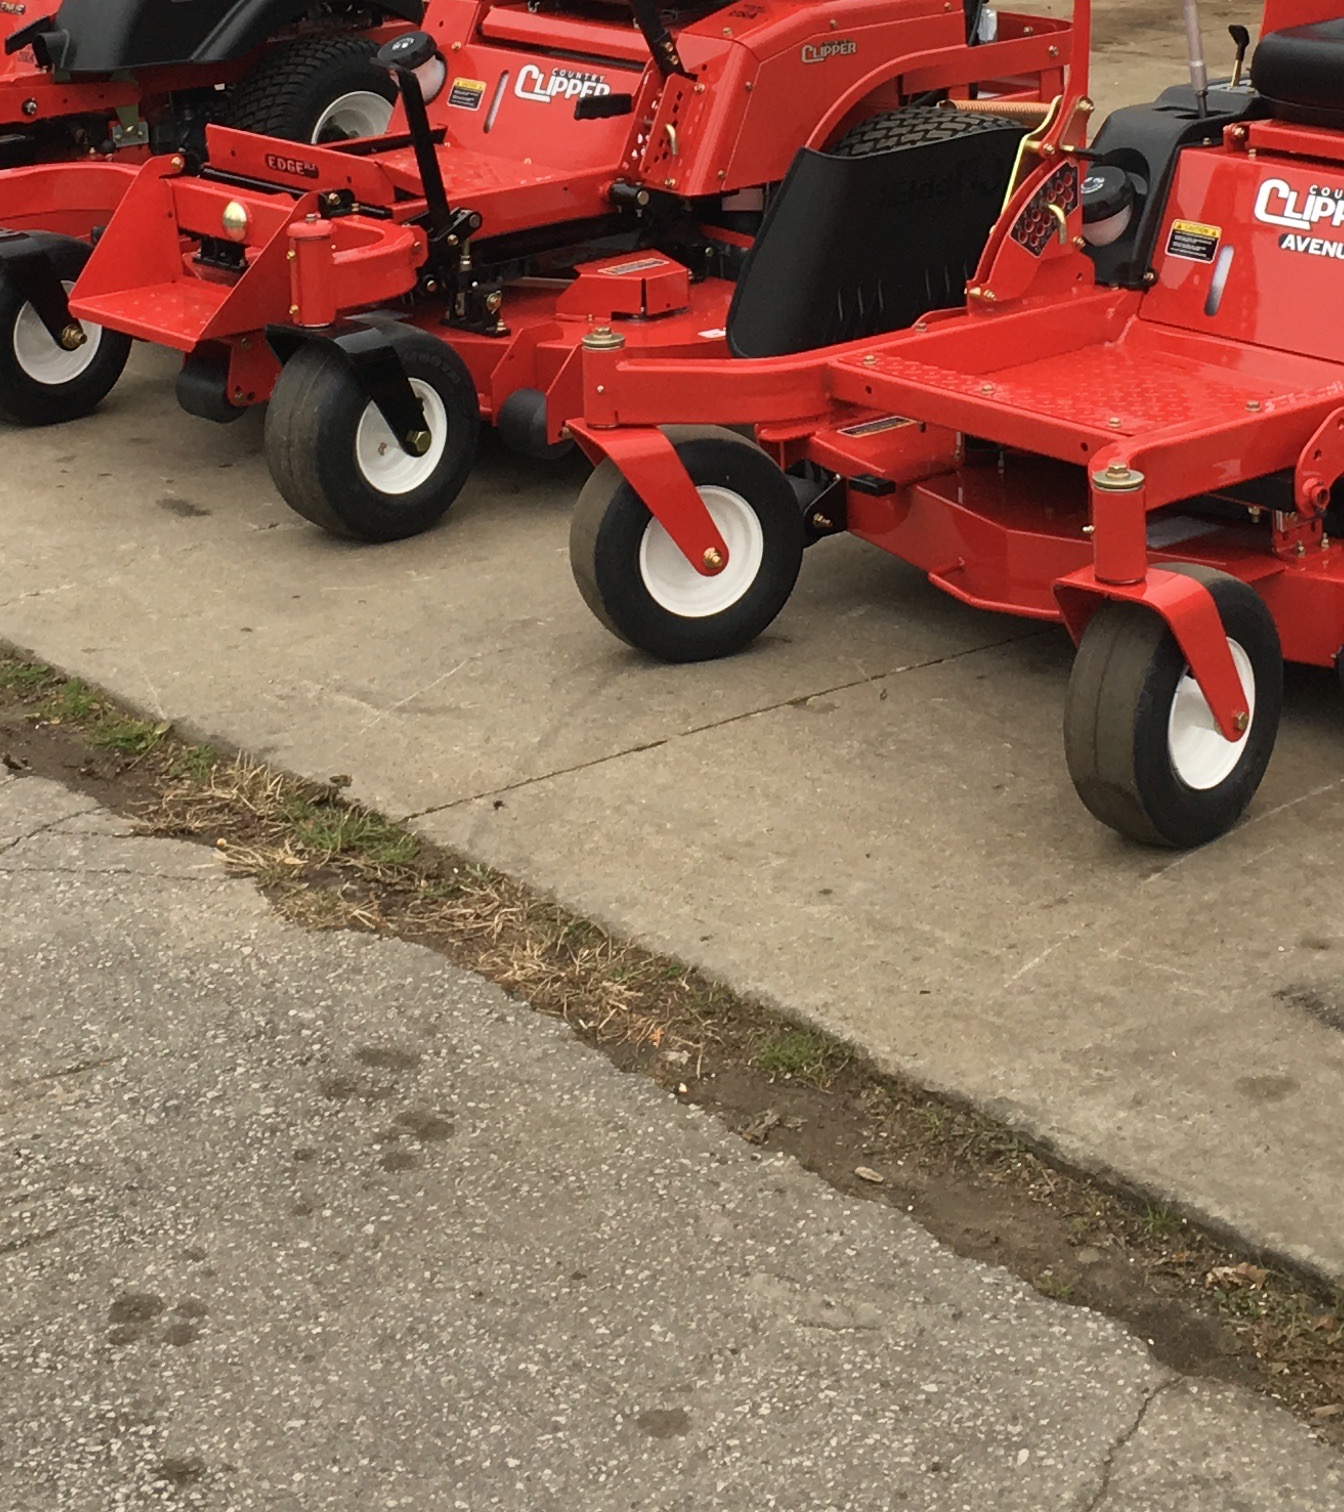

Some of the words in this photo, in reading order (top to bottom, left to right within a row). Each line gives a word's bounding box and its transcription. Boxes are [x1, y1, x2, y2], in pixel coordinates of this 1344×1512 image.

[801, 42, 857, 64] CLIPPER
[514, 64, 611, 103] CLIPPER
[552, 68, 606, 83] COUNTRY
[268, 155, 305, 175] EDGE
